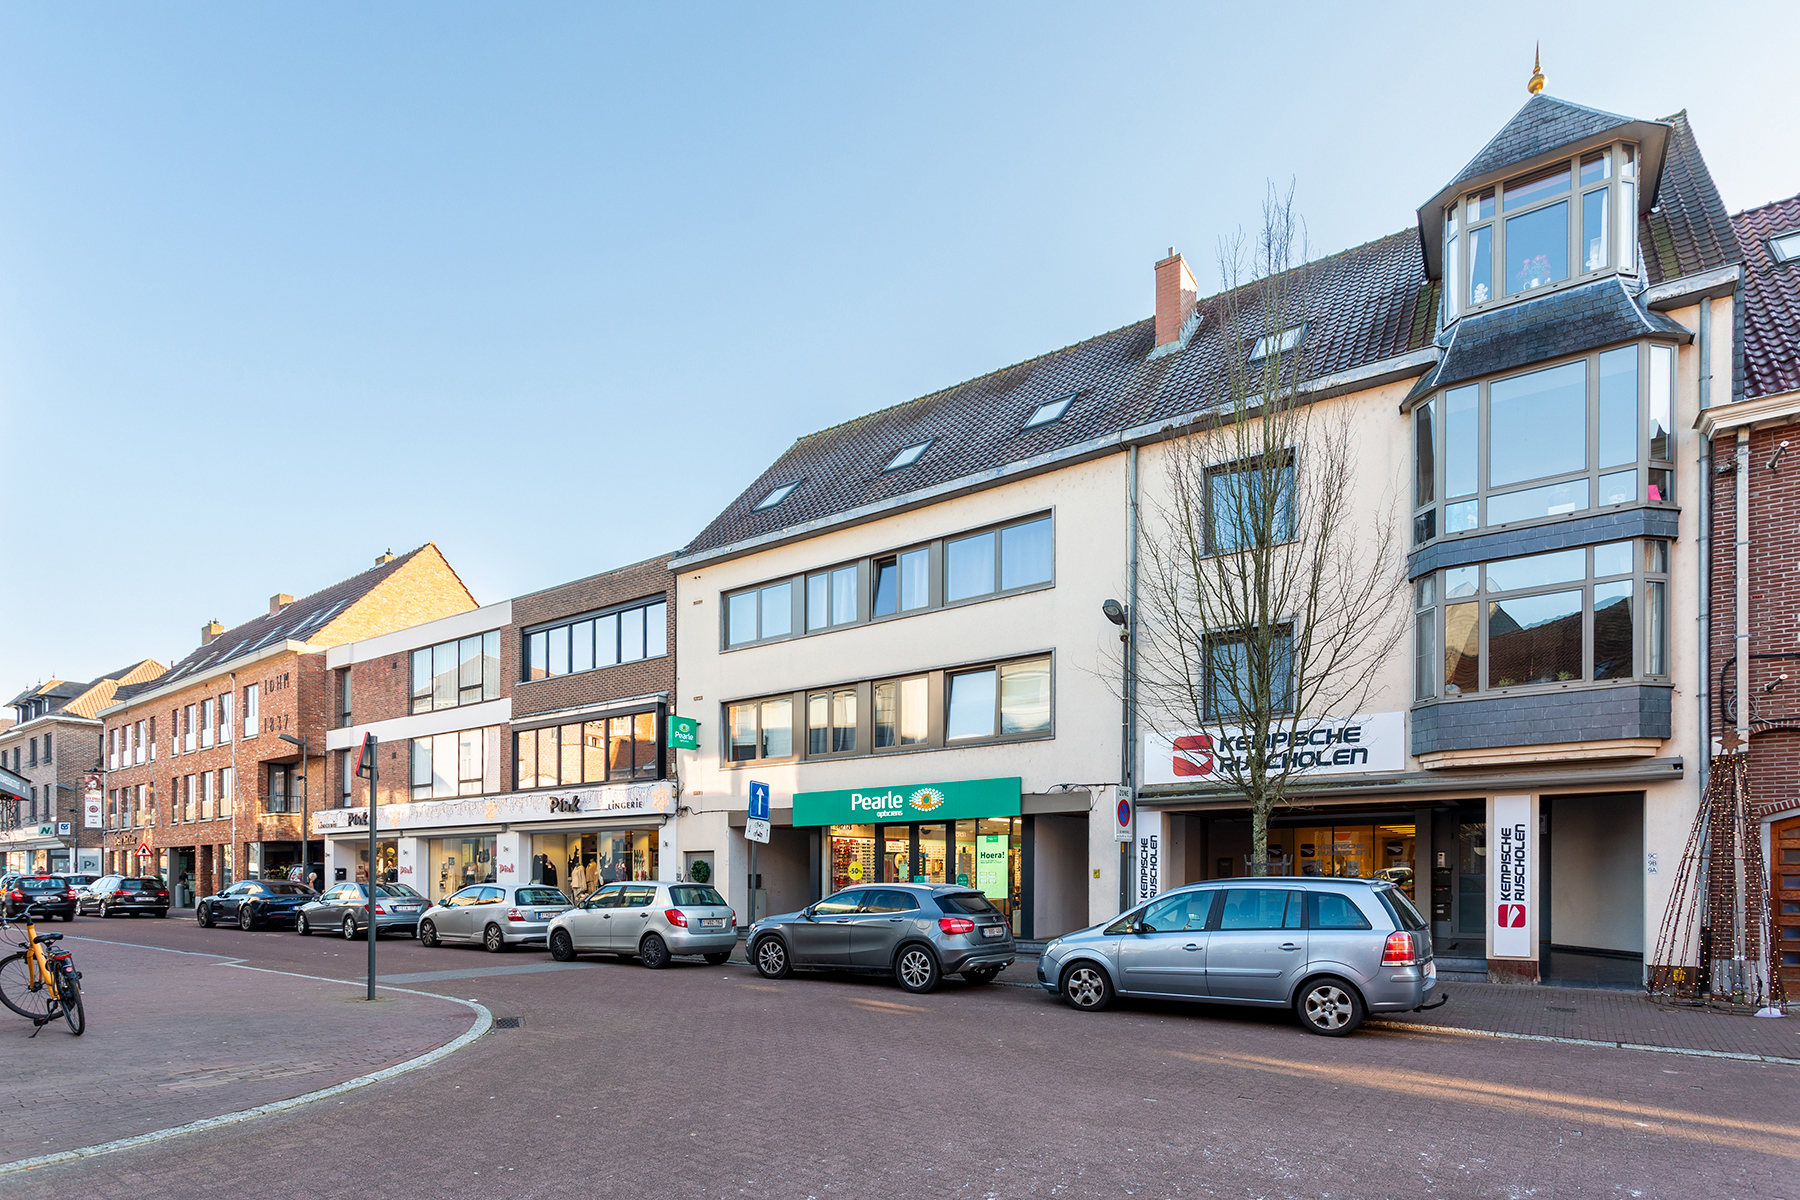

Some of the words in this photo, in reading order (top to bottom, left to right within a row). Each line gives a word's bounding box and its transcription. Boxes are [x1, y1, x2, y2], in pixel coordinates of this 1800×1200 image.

[264, 714, 289, 733] 1837
[675, 731, 693, 740] Pearle
[1219, 748, 1369, 772] RIJCHOLEN
[549, 795, 580, 813] Pink
[607, 798, 643, 810] LINGERIE
[851, 790, 903, 811] Pearle
[980, 851, 1005, 859] Hoera!
[1501, 828, 1512, 901] KEMPISCHE
[1514, 824, 1525, 901] RIJSCHOLEN
[1150, 835, 1158, 898] RIJSCHOLEN
